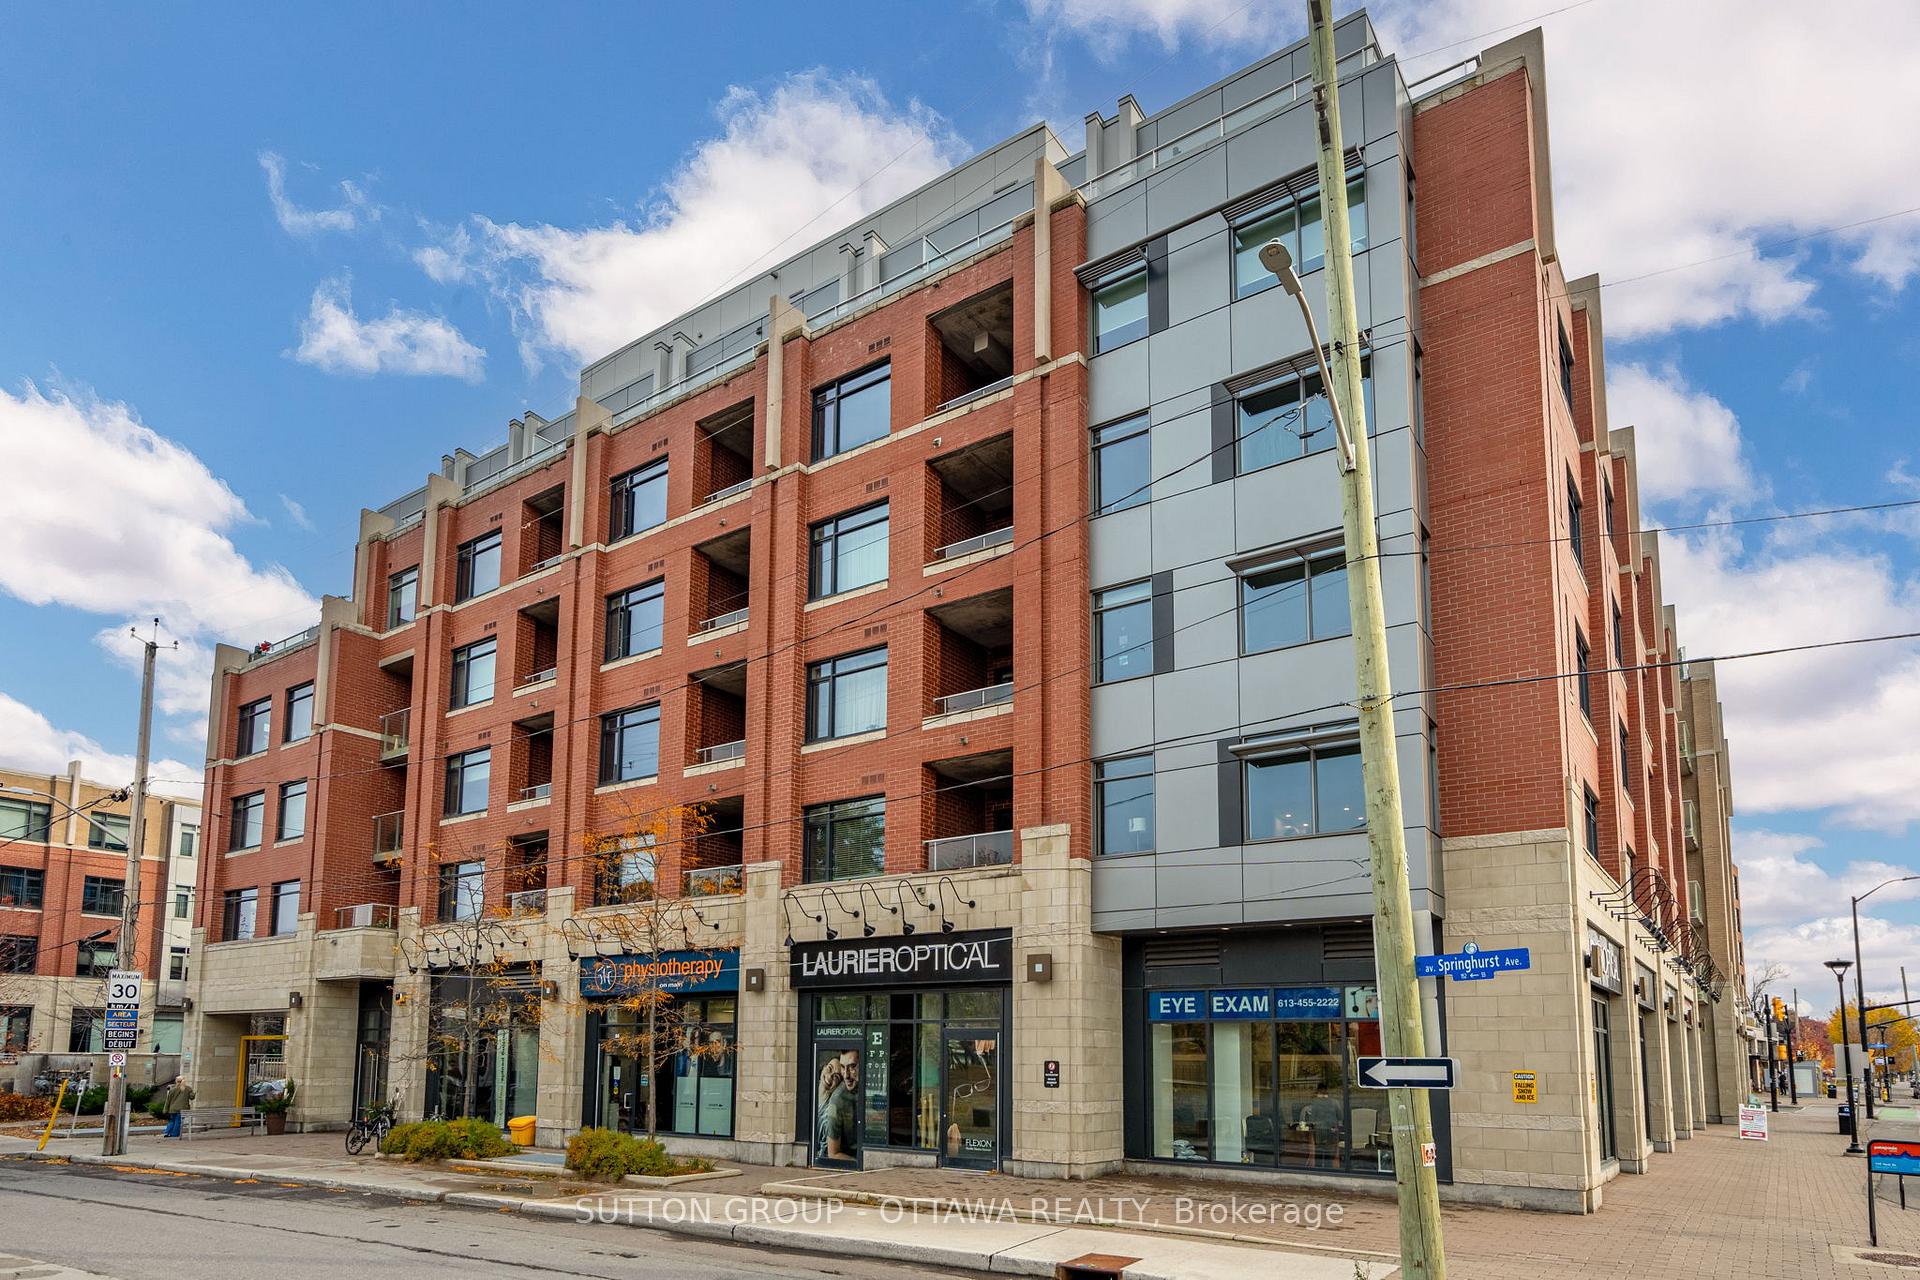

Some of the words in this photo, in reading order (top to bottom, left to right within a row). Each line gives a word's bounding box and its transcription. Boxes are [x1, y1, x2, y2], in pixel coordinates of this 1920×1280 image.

[802, 942, 1000, 976] LAURIEROPTICAL
[1425, 965, 1436, 973] av.
[1438, 955, 1500, 974] Springhurst
[1505, 957, 1522, 966] Ave.
[623, 958, 723, 983] physiotherapy
[112, 984, 137, 998] 30
[1159, 997, 1196, 1014] EYE
[1212, 995, 1269, 1013] EXAM
[1277, 998, 1340, 1008] 613-455-2222
[108, 1039, 133, 1048] DÉBUT
[872, 1031, 882, 1045] E
